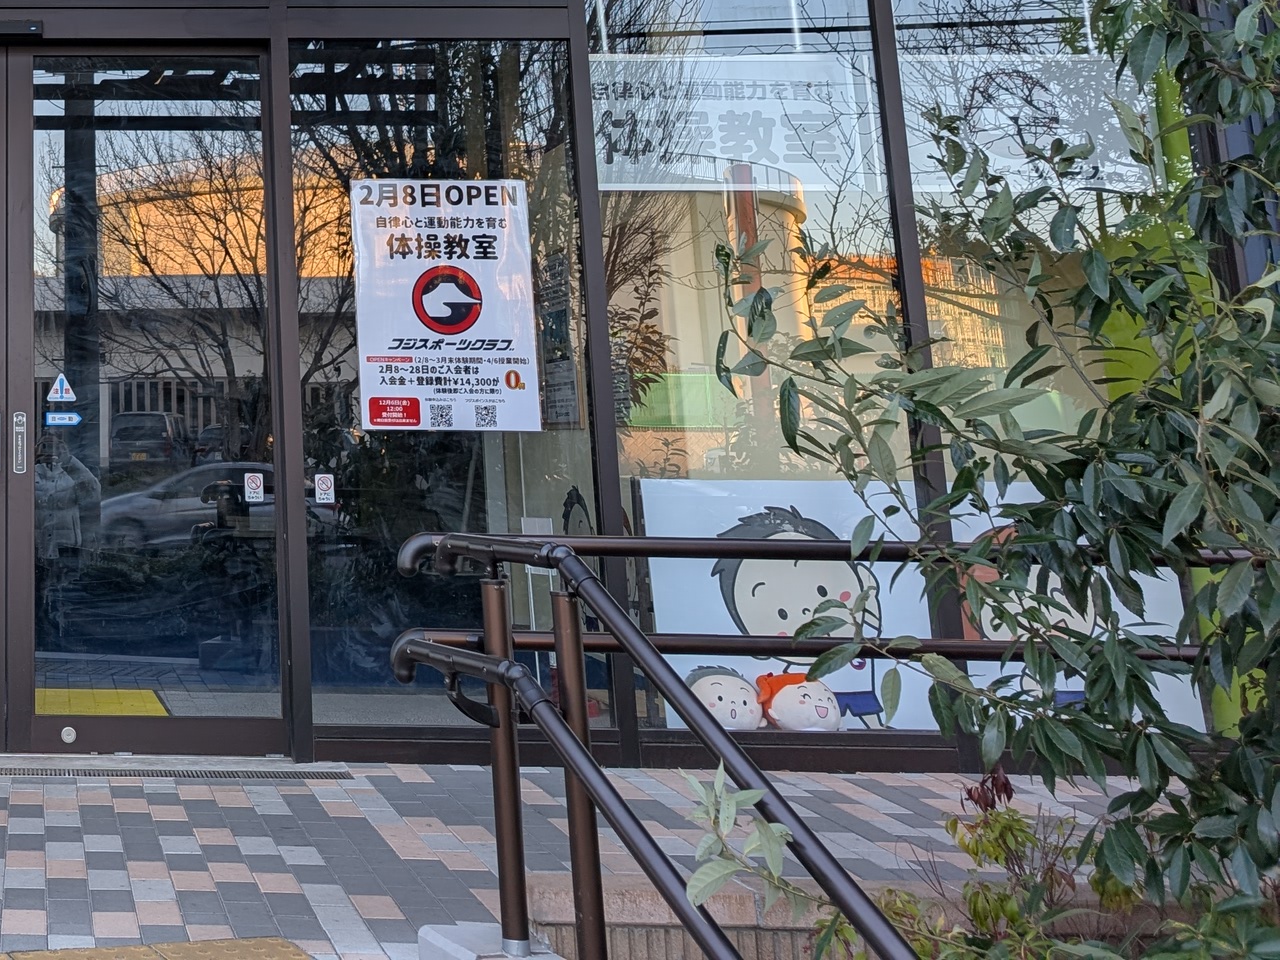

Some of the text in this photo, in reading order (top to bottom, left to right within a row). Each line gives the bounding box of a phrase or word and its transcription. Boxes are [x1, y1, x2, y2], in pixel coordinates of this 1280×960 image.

[359, 184, 518, 208] 2月8日OPEN
[376, 216, 507, 229] 自律心と運動能力を育む
[386, 233, 498, 260] 体操教室
[388, 338, 515, 351] フジスポーツクラブ
